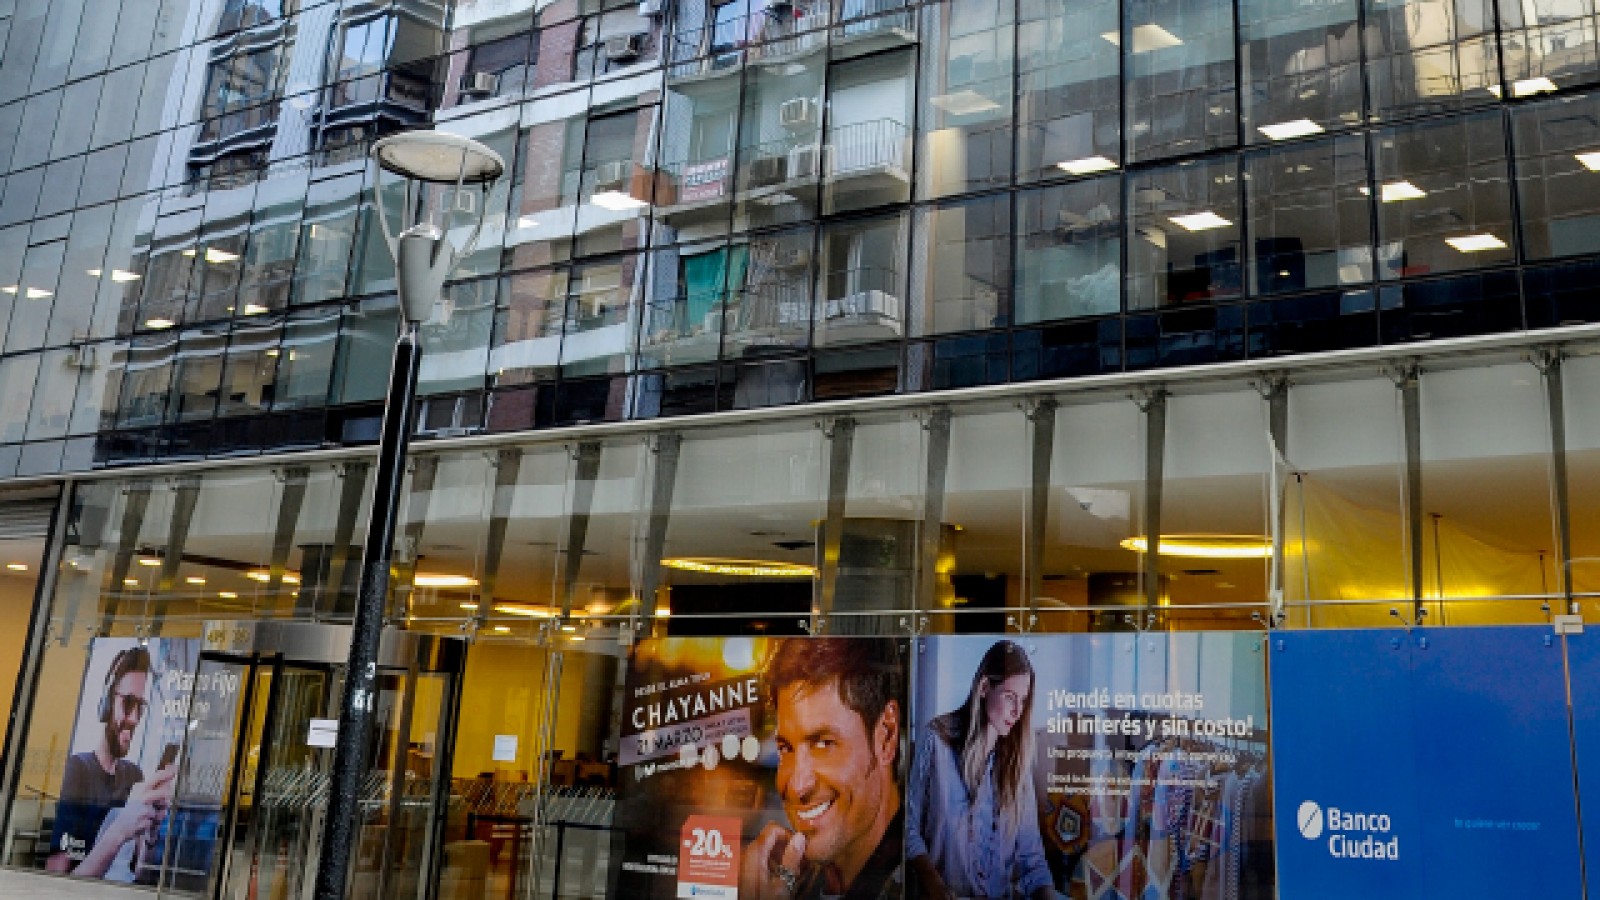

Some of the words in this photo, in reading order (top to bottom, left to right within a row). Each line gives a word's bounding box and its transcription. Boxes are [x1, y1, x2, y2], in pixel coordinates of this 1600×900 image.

[631, 679, 759, 729] CHAYANNE
[1047, 687, 1111, 710] ¡Vendé
[1115, 693, 1136, 709] en
[1141, 691, 1204, 710] cuotas
[1047, 712, 1073, 734] sin
[1077, 712, 1141, 736] interés
[1145, 719, 1155, 741] y
[1162, 714, 1189, 736] sin
[1194, 714, 1254, 737] costo!
[1327, 806, 1391, 832] Banco
[1328, 834, 1399, 861] Ciudad
